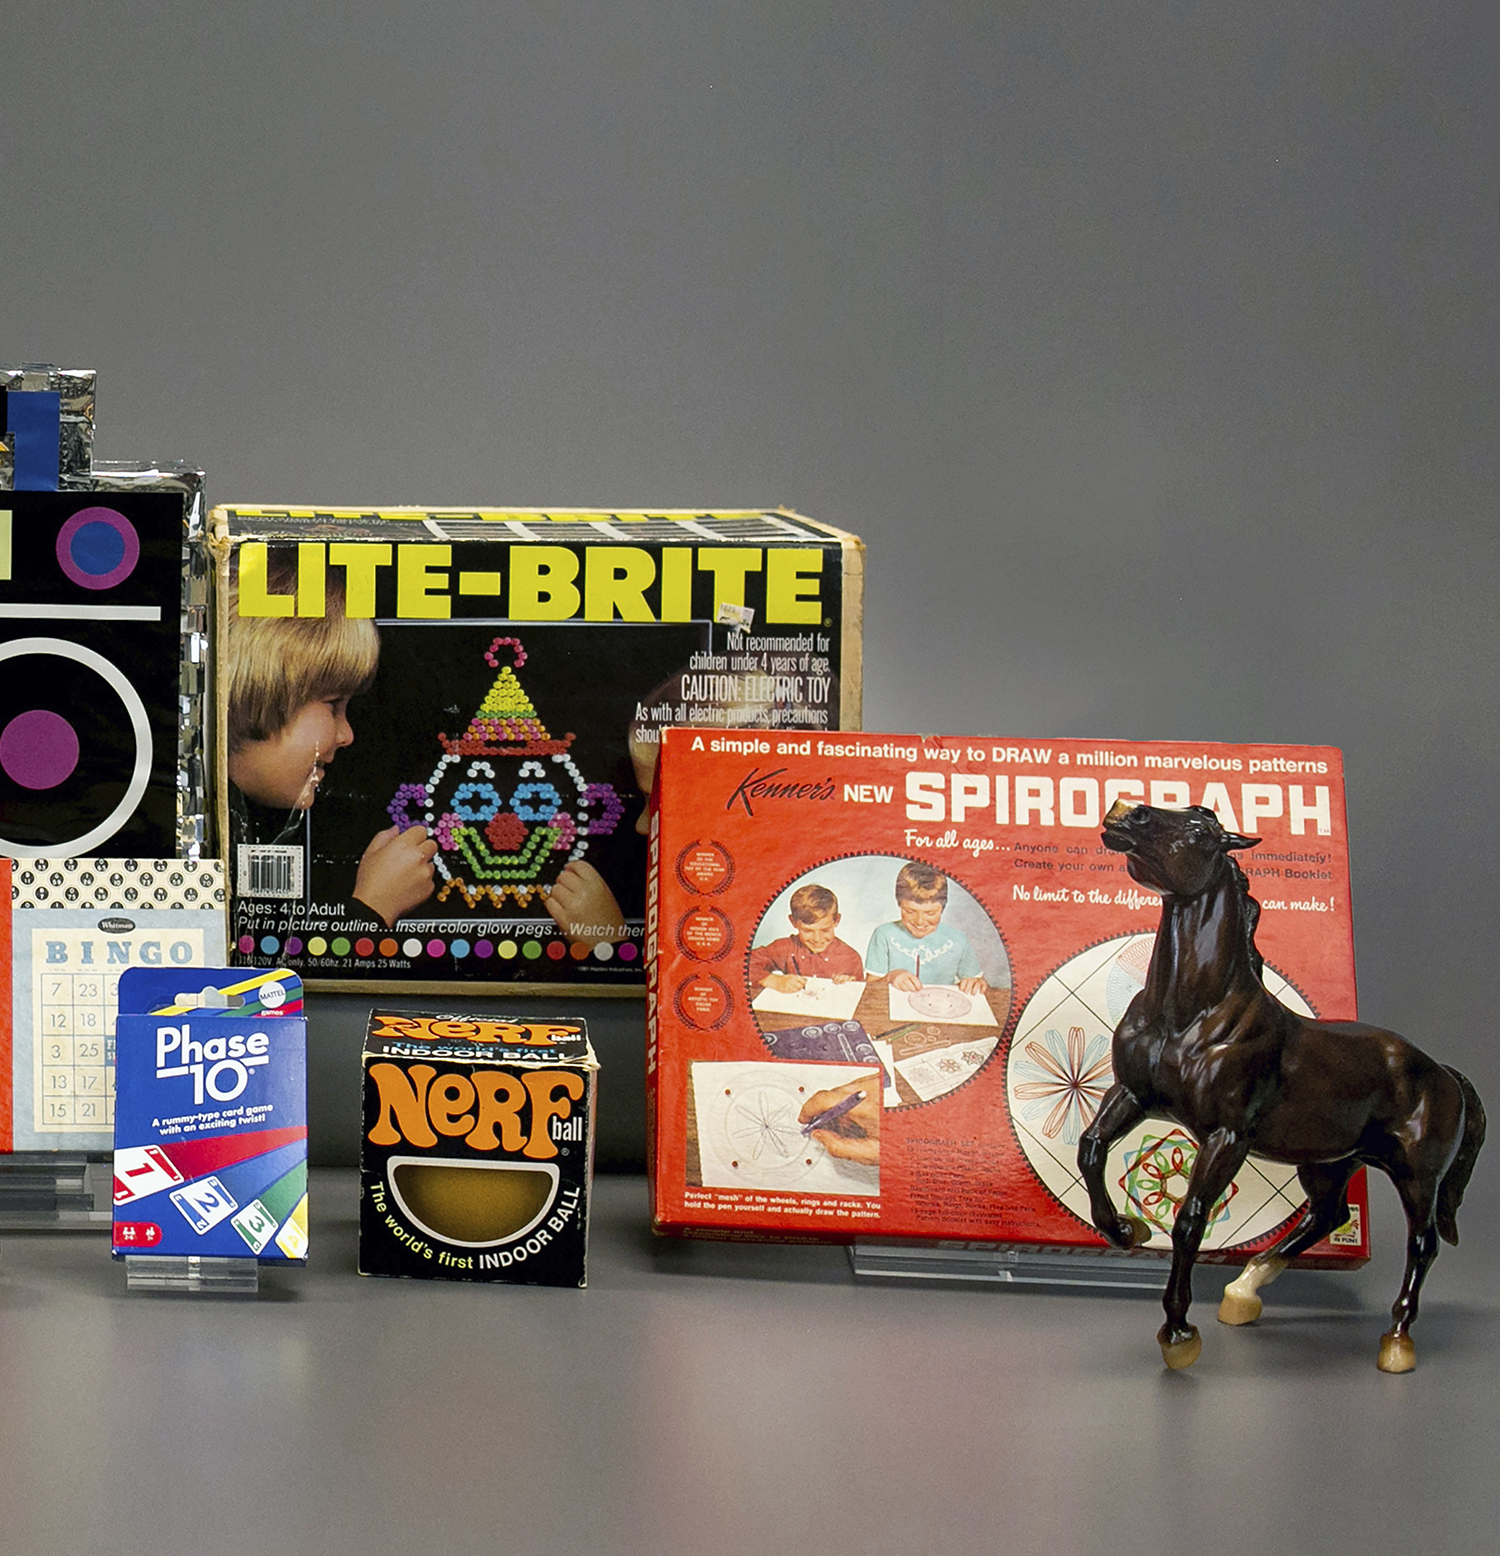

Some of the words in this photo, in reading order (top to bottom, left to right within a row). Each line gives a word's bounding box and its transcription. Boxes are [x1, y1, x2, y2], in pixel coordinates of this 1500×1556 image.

[239, 542, 824, 624] LITE-BRITE
[727, 631, 743, 651] Not
[746, 633, 813, 652] recommended
[817, 633, 830, 652] for
[690, 651, 727, 671] children
[731, 653, 758, 671] under
[771, 656, 797, 673] years
[811, 657, 830, 676] age.
[681, 674, 742, 702] CAUTION:
[744, 675, 803, 703] ELECTRIC
[806, 677, 831, 704] TOY
[635, 702, 648, 721] As
[651, 702, 672, 721] with
[675, 703, 687, 721] all
[689, 703, 724, 723] electric
[772, 706, 829, 726] precautions
[691, 736, 705, 751] A
[710, 737, 770, 758] simple
[776, 740, 811, 756] and
[817, 740, 917, 762] fascinating
[924, 748, 960, 764] way
[967, 746, 985, 762] to
[992, 747, 1052, 765] DRAW
[1058, 753, 1069, 765] a
[1076, 750, 1138, 768] million
[1145, 752, 1242, 771] marvelous
[1249, 757, 1328, 775] patterns
[726, 767, 836, 817] Kenner's
[843, 784, 894, 803] NEW
[903, 828, 933, 847] For
[936, 829, 959, 848] all
[1014, 842, 1059, 856] Anyone
[1066, 845, 1088, 855] can
[1252, 850, 1332, 864] immediately!
[1014, 858, 1054, 870] Create
[1058, 862, 1085, 872] your
[1089, 863, 1114, 872] own
[1285, 868, 1332, 880] Booklet
[1013, 884, 1030, 902] No
[1033, 885, 1070, 903] limit
[1071, 889, 1085, 904] to
[1087, 887, 1111, 905] the
[1114, 888, 1163, 910] differe
[1262, 899, 1288, 911] can
[238, 902, 276, 916] Ages:
[308, 902, 345, 916] Adult
[238, 917, 261, 930] Put
[262, 917, 275, 930] in
[278, 918, 328, 933] picture
[438, 920, 473, 934] color
[477, 920, 513, 937] glow
[389, 959, 411, 969] Watts
[79, 983, 98, 998] 23
[260, 990, 285, 1000] MATTEL
[51, 1014, 67, 1028] 12
[82, 1014, 97, 1028] 18
[79, 1043, 99, 1058] 25
[156, 1024, 270, 1068] Phase
[382, 1045, 494, 1059] INDOOR
[503, 1051, 568, 1061] BALL
[51, 1076, 68, 1090] 13
[82, 1076, 98, 1090] 17
[189, 1058, 249, 1106] 10
[50, 1104, 67, 1118] 15
[151, 1118, 160, 1127] A
[162, 1110, 220, 1124] rummy-type
[222, 1105, 244, 1118] card
[245, 1104, 274, 1116] game
[159, 1125, 182, 1136] with
[183, 1124, 197, 1133] an
[198, 1118, 237, 1129] exciting
[238, 1113, 266, 1125] twist!
[552, 1117, 583, 1142] ball
[193, 1191, 220, 1213] 2
[684, 1191, 712, 1200] Perfect
[801, 1199, 820, 1208] rings
[823, 1199, 837, 1207] and
[866, 1201, 881, 1209] You
[718, 1203, 732, 1211] pen
[734, 1204, 765, 1212] yourself
[767, 1205, 782, 1213] and
[784, 1206, 813, 1217] actually
[815, 1208, 835, 1216] draw
[370, 1181, 387, 1213] The
[385, 1215, 434, 1260] world's
[438, 1252, 474, 1270] first
[479, 1229, 553, 1270] INDOOR
[548, 1186, 581, 1233] BALL
